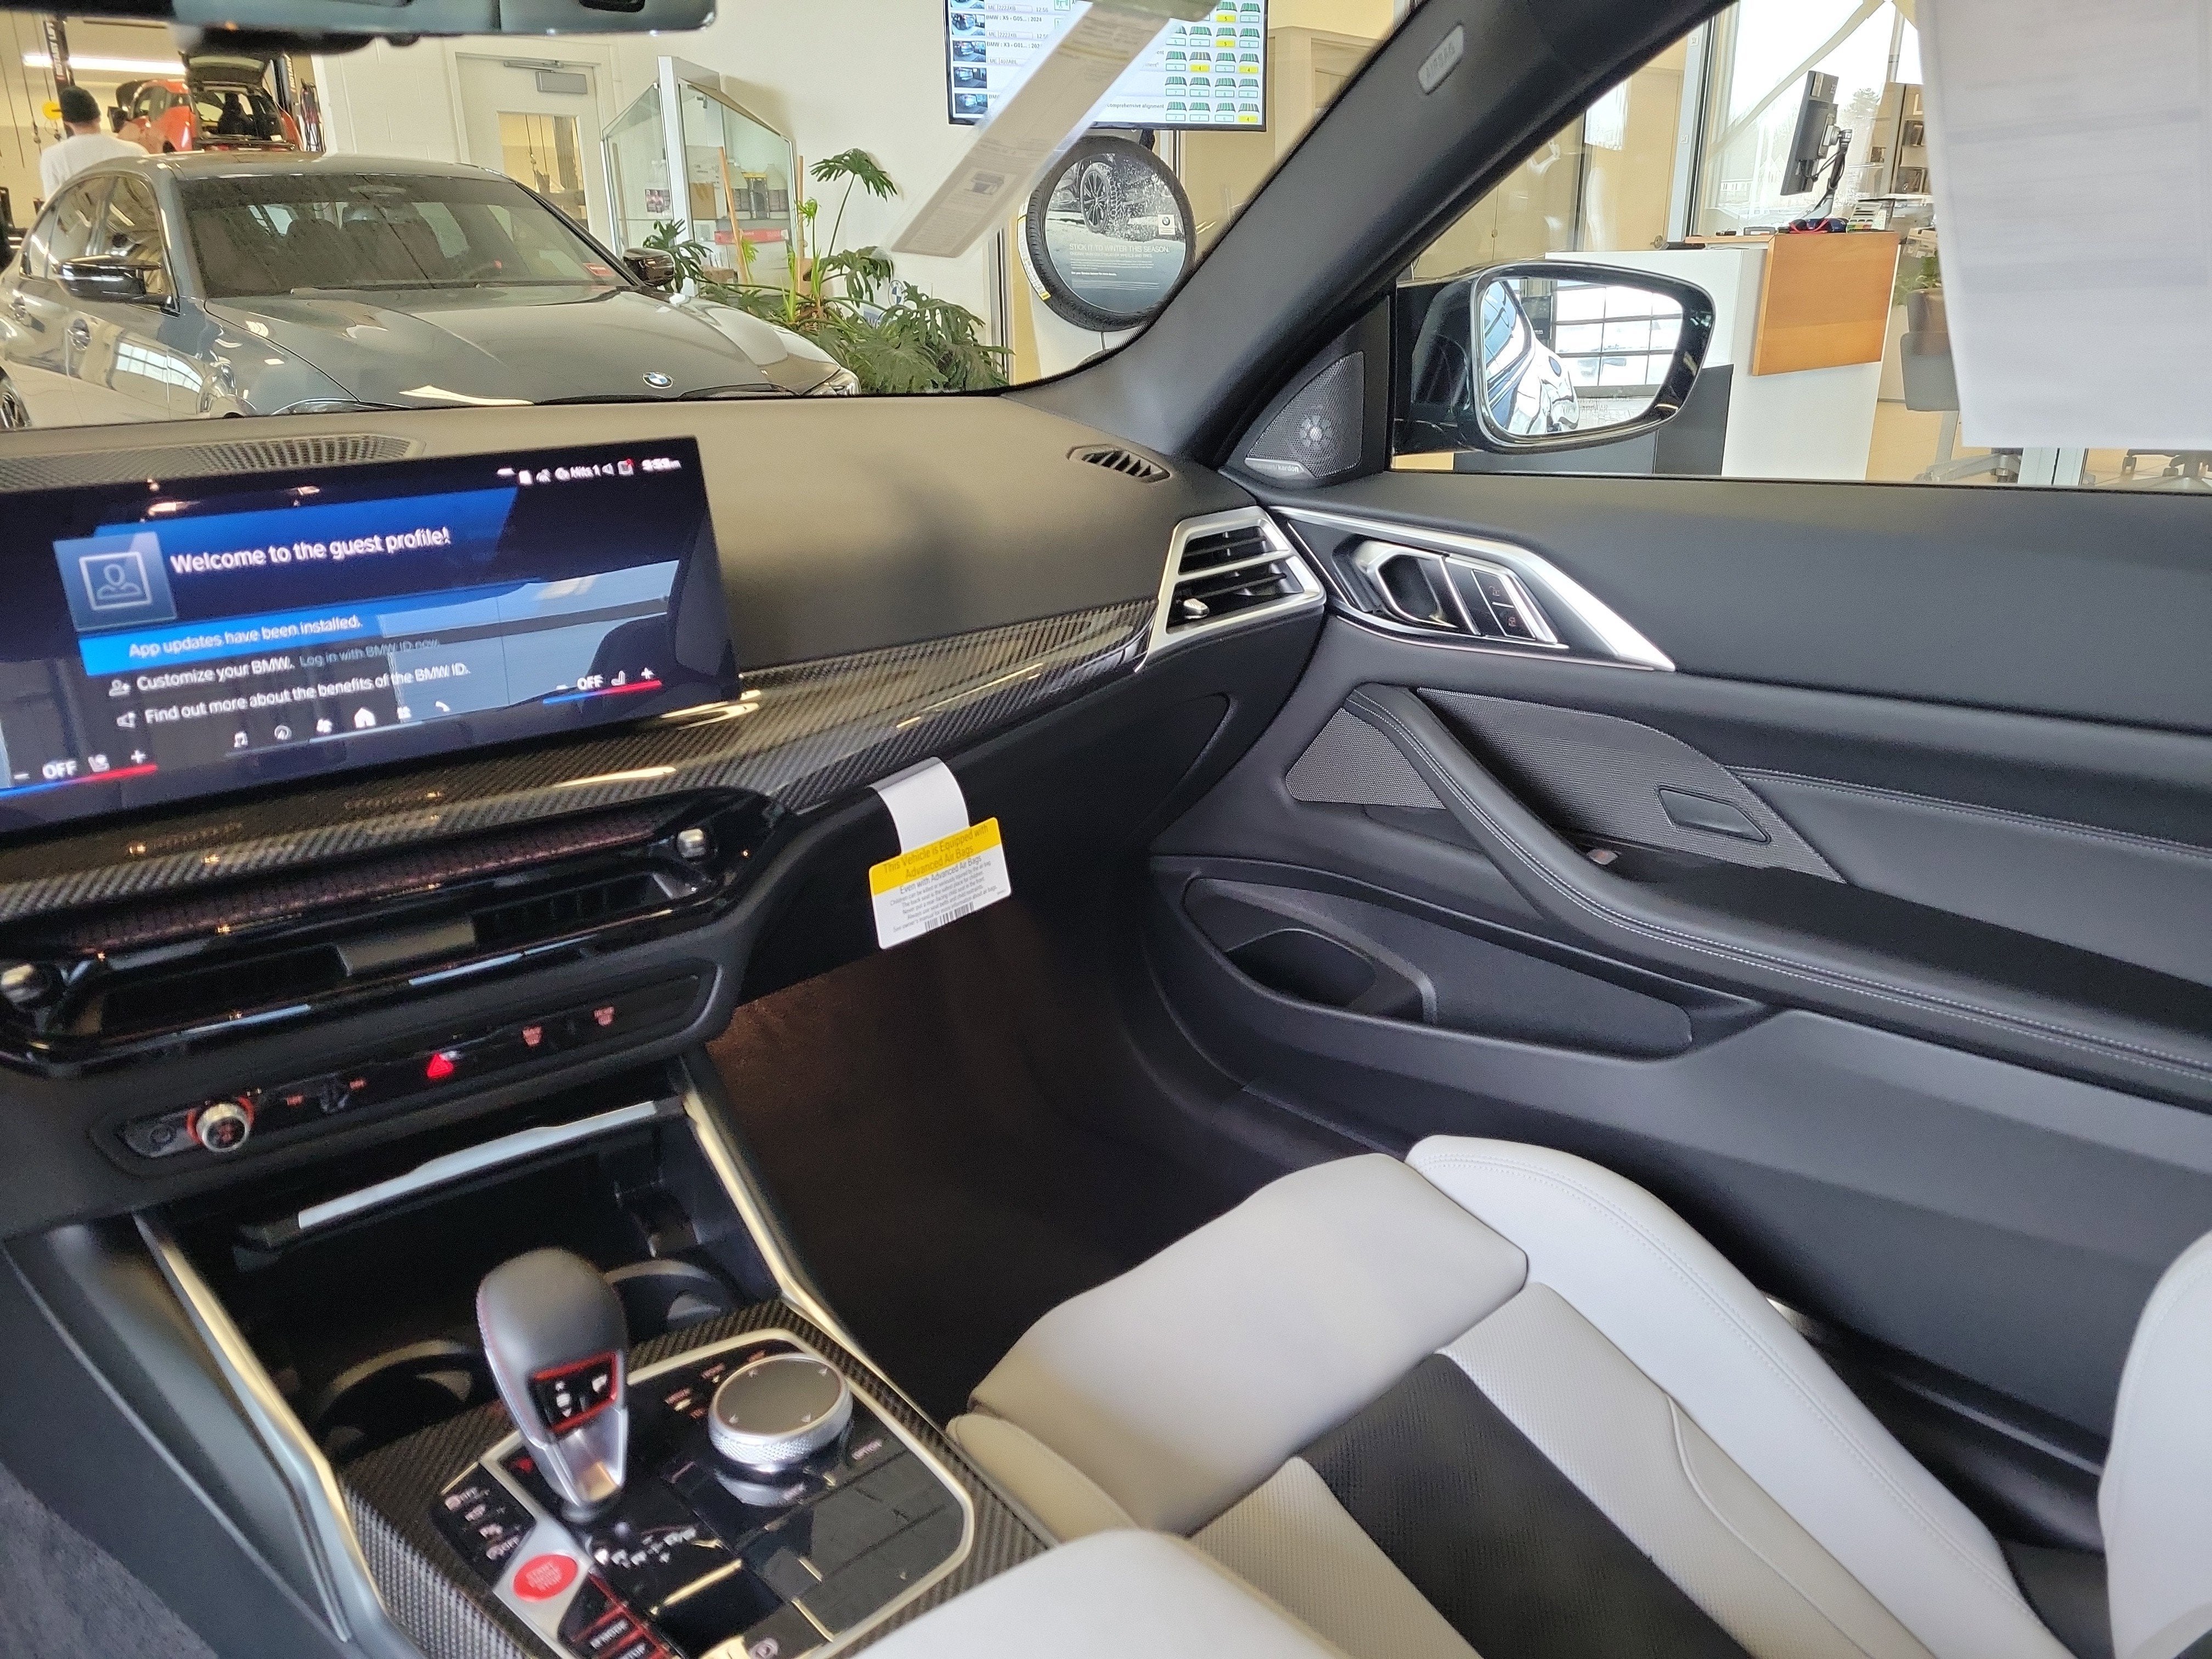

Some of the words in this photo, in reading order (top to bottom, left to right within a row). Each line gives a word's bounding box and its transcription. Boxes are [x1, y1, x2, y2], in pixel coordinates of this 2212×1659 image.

[170, 549, 267, 573] Welcome
[268, 545, 291, 563] to
[292, 541, 328, 560] the
[329, 534, 385, 561] guest
[385, 526, 451, 554] profile!
[128, 644, 161, 658] App
[163, 634, 224, 654] updates
[224, 629, 259, 644] have
[262, 624, 298, 640] been
[300, 614, 363, 635] installed.
[137, 669, 216, 691] Customize
[216, 663, 250, 682] your
[250, 656, 295, 675] BMW.
[299, 655, 325, 668] Log
[326, 652, 339, 663] in
[339, 648, 365, 661] with
[365, 642, 396, 657] BMW
[399, 640, 414, 652] ID
[577, 675, 603, 690] OFF
[144, 705, 180, 724] Find
[181, 702, 208, 718] out
[209, 697, 247, 714] more
[249, 689, 291, 708] about
[292, 687, 318, 702] the
[318, 677, 375, 698] benefits
[375, 673, 392, 689] of
[391, 670, 414, 685] the
[414, 664, 449, 682] BMW
[451, 662, 471, 676] ID.
[43, 761, 77, 779] OFF
[884, 861, 900, 874] This
[901, 849, 930, 866] Vehicle
[933, 844, 939, 854] is
[939, 832, 973, 851] Equipped
[975, 823, 988, 837] with
[906, 859, 943, 879] Advanced
[945, 852, 955, 863] Air
[957, 844, 974, 860] Bags
[900, 883, 916, 894] Even
[917, 875, 930, 887] with
[933, 865, 959, 881] Advanced
[968, 855, 982, 867] Bags
